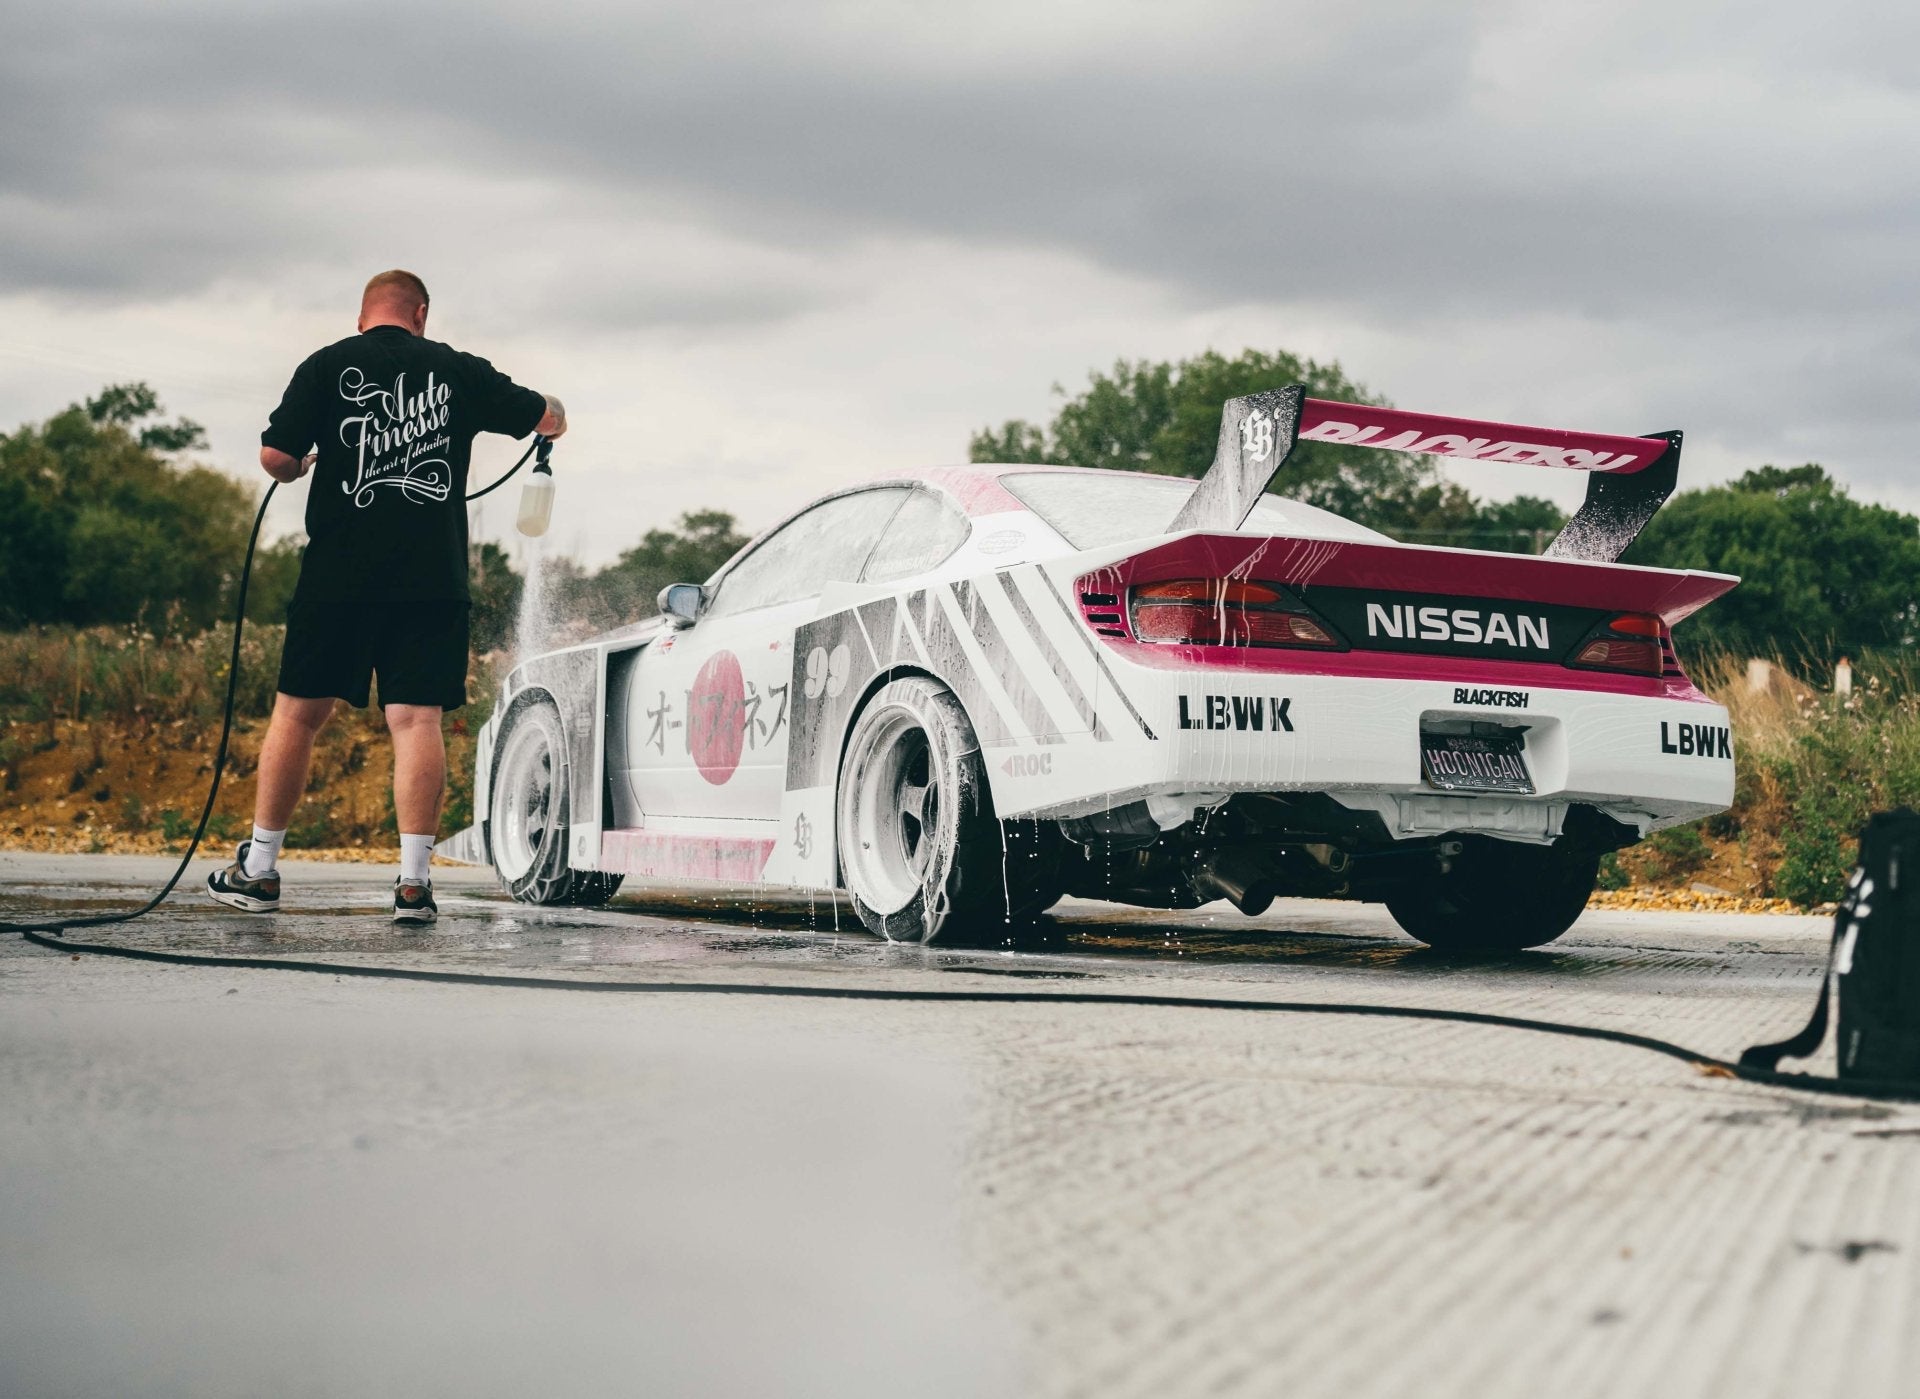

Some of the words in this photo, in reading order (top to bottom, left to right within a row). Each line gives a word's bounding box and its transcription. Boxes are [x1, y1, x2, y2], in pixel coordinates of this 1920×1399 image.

[357, 370, 452, 431] Auto
[340, 404, 450, 494] Finesse
[365, 458, 381, 479] the
[383, 456, 398, 472] art
[401, 443, 413, 472] of
[411, 433, 450, 458] detailing
[1366, 603, 1550, 650] NISSAN
[804, 644, 850, 699] 99
[1177, 695, 1295, 732] LBWK
[1453, 687, 1529, 708] BLACKFISH
[1661, 721, 1732, 760] LBWK
